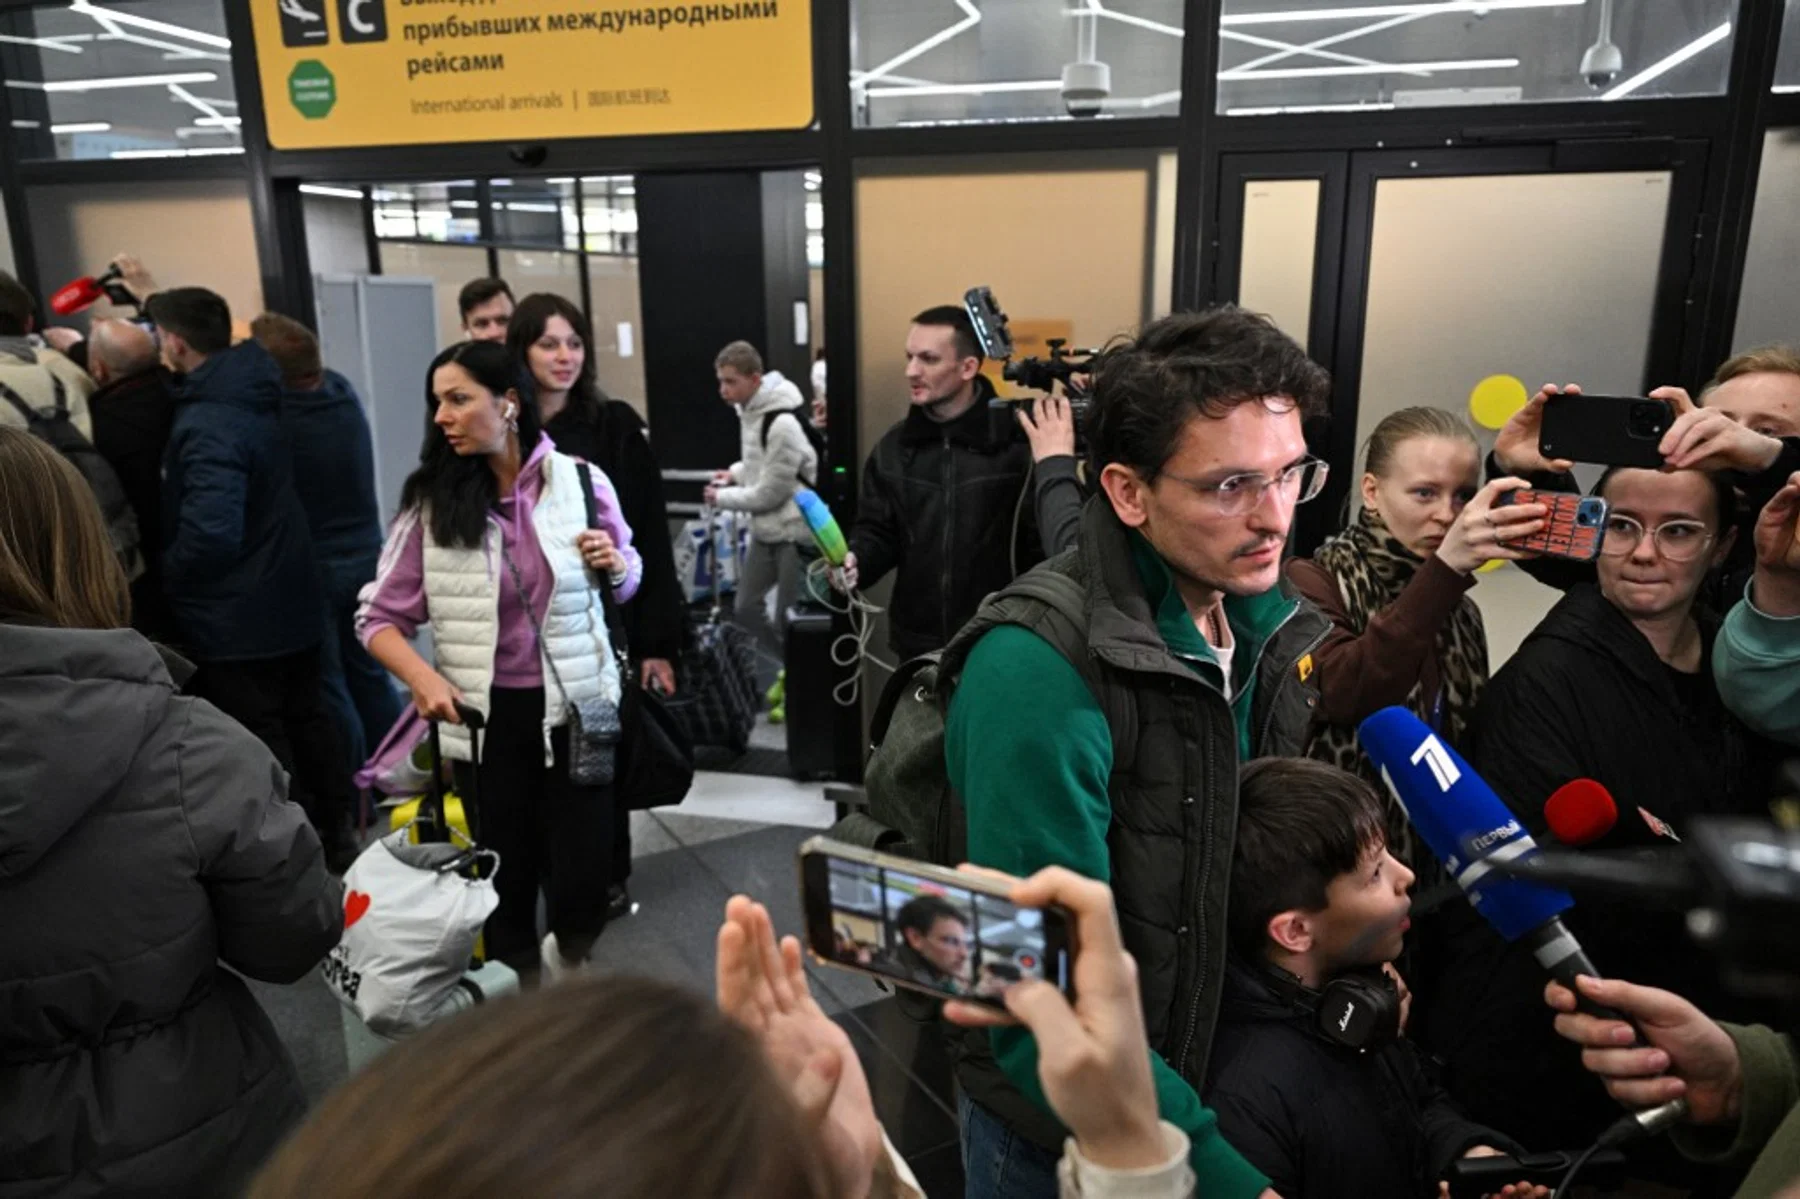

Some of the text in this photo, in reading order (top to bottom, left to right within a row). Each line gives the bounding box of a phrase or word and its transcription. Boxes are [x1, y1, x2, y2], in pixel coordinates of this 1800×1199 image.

[403, 0, 779, 45] прибывших международными
[407, 51, 504, 79] рейсами
[410, 91, 563, 115] International arrivals
[1410, 733, 1461, 792] 1
